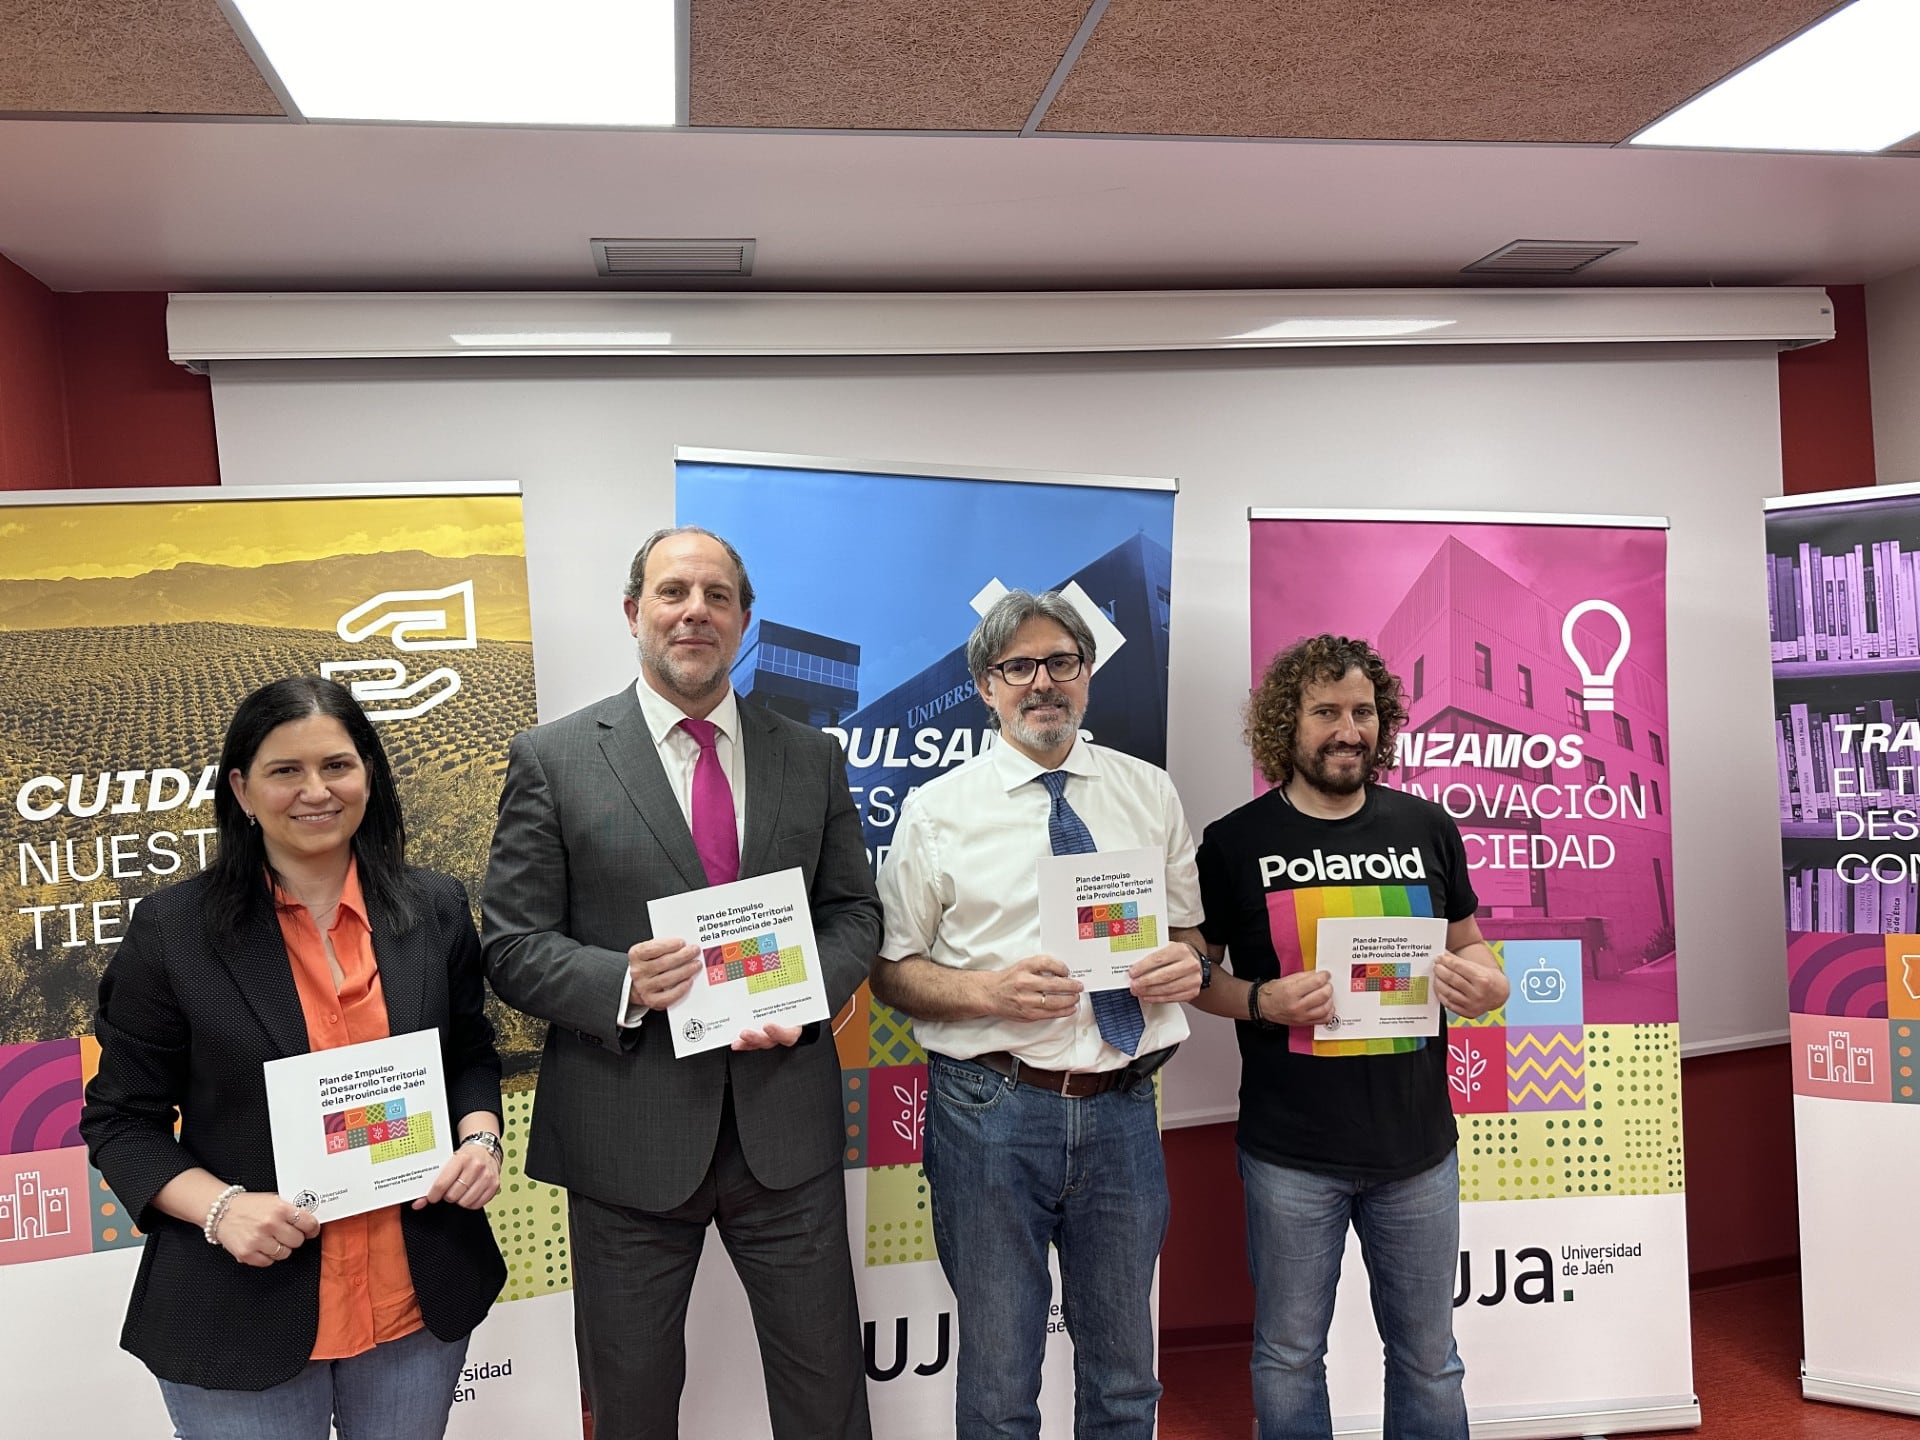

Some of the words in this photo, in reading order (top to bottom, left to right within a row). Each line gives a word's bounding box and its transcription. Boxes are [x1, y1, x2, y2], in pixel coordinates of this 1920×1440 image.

[1834, 767, 1881, 797] EL
[1836, 810, 1920, 841] DES
[1102, 872, 1130, 881] Impulso
[1259, 847, 1426, 887] Polaroid
[1084, 883, 1119, 891] Desarrollo
[1120, 878, 1153, 887] Territorial
[1094, 890, 1125, 899] Provincia
[19, 898, 143, 950] TIE
[697, 913, 717, 923] Plan
[716, 910, 727, 918] de
[727, 903, 764, 915] Impulso
[707, 916, 751, 930] Desarrollo
[751, 904, 793, 919] Territorial
[721, 922, 760, 937] Provincia
[761, 920, 771, 928] de
[772, 915, 793, 925] Jaén
[319, 1076, 340, 1086] Plan
[341, 1074, 353, 1082] de
[354, 1065, 394, 1079] Impulso
[320, 1088, 329, 1096] al
[330, 1078, 379, 1094] Desarrollo
[381, 1067, 427, 1083] Territorial
[321, 1099, 334, 1107] de
[335, 1096, 344, 1104] la
[345, 1086, 388, 1102] Provincia
[389, 1084, 401, 1092] de
[403, 1079, 425, 1090] Jaén
[1562, 1243, 1641, 1259] Universidad
[1562, 1262, 1578, 1276] de
[1582, 1259, 1613, 1275] Jaén
